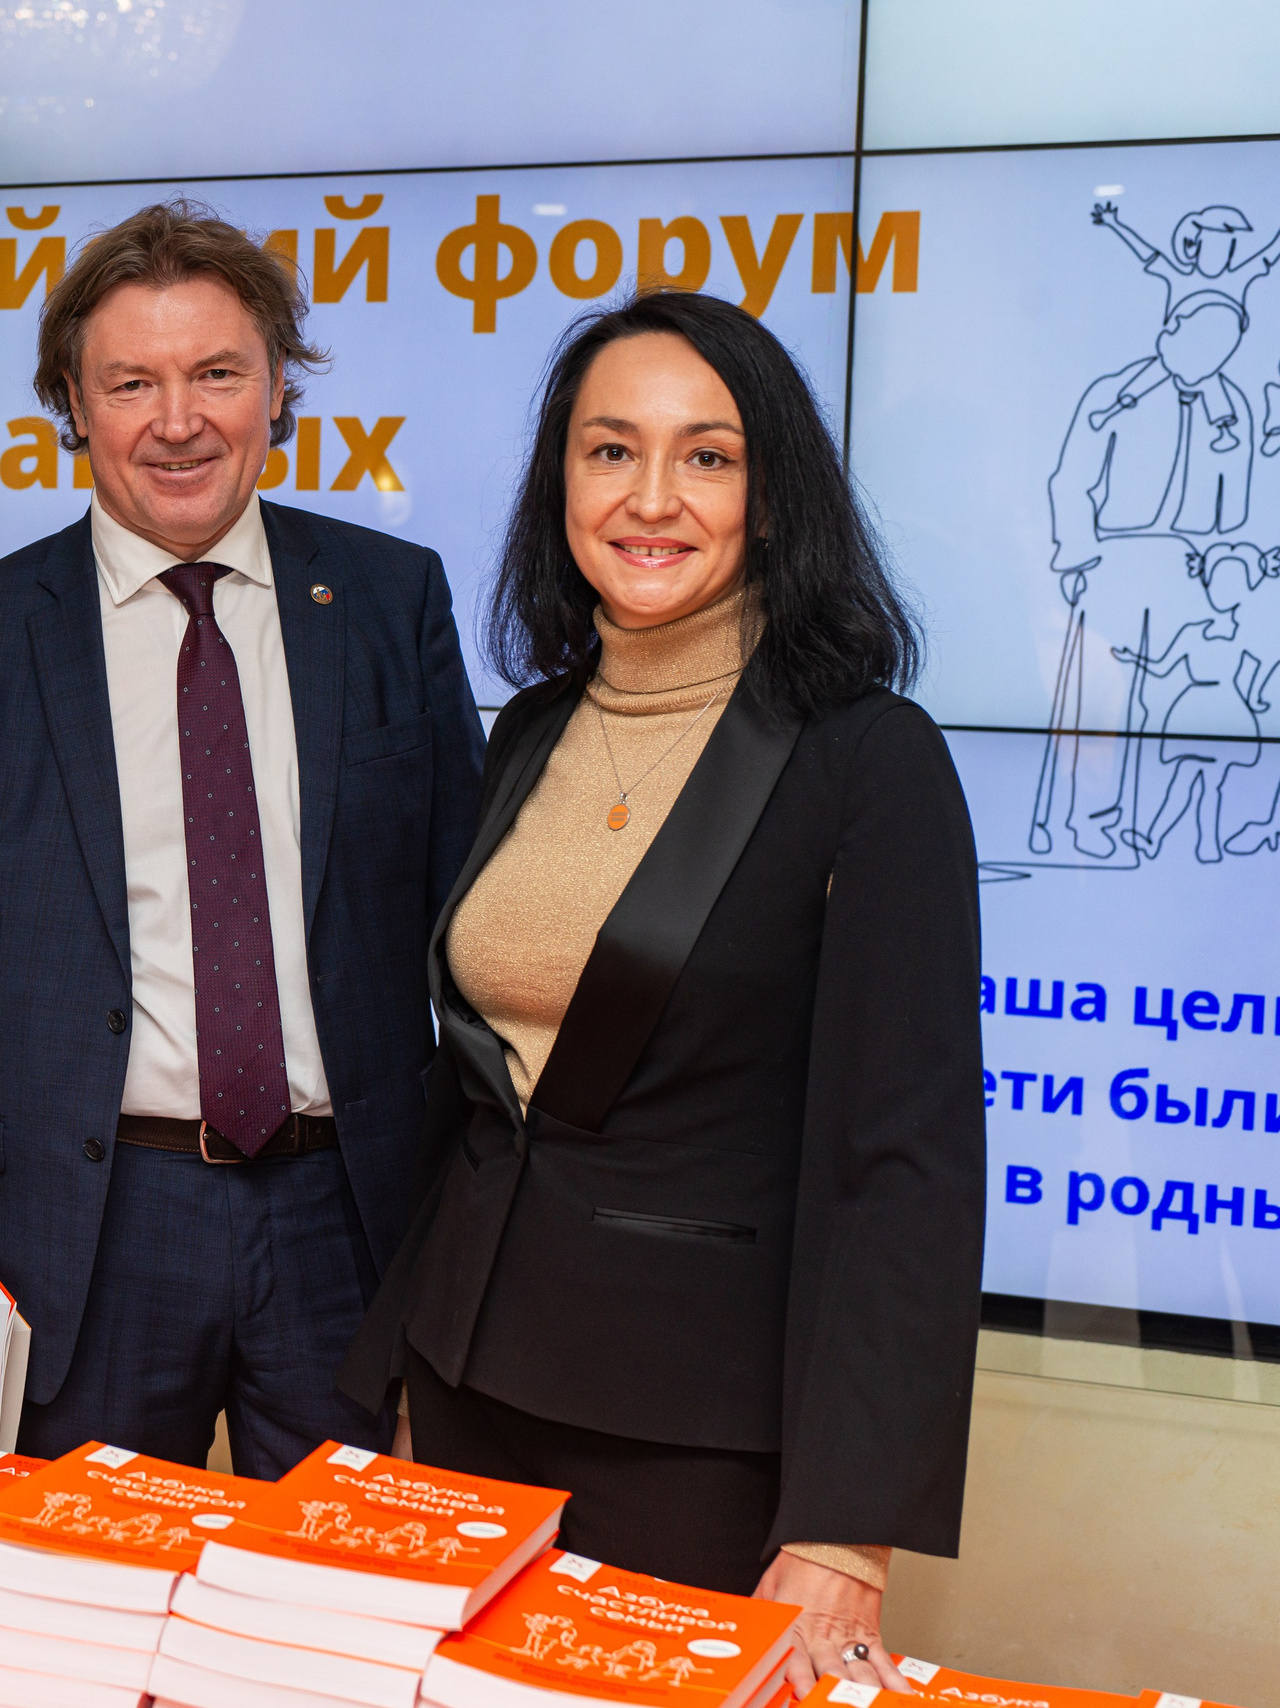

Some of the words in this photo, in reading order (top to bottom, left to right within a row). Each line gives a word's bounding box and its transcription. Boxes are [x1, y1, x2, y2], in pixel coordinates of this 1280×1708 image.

[434, 194, 920, 334] форум
[1133, 985, 1280, 1042] цел
[1005, 1164, 1043, 1205] в
[87, 1470, 247, 1510] счастливой
[112, 1486, 197, 1510] семьи
[125, 1471, 226, 1498] Азбука
[333, 1474, 505, 1516] счастливой
[372, 1473, 479, 1502] Азбука
[365, 1492, 455, 1516] семьи
[557, 1584, 738, 1632] счастливой
[597, 1585, 710, 1618] Азбука
[590, 1606, 685, 1634] семьи
[940, 1686, 1049, 1708] Азбука
